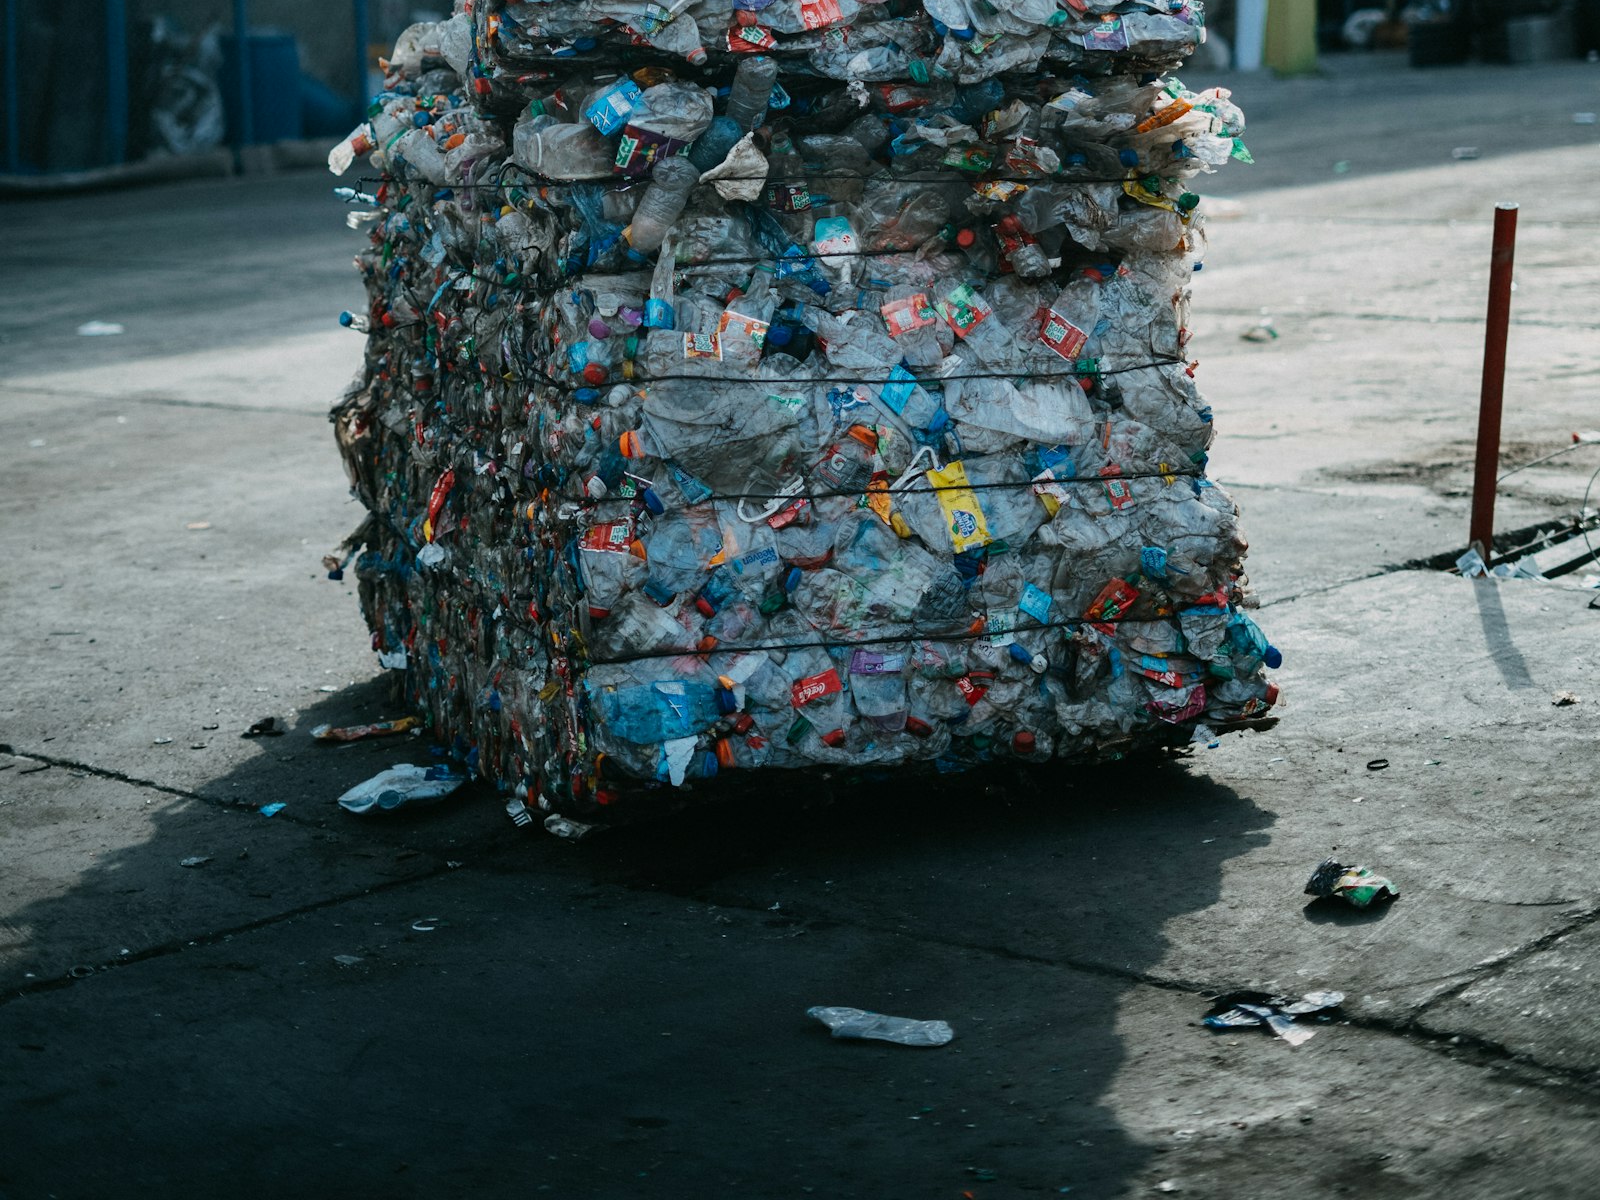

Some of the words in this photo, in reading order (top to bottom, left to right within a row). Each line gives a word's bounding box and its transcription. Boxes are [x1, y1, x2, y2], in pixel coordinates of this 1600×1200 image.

[1046, 327, 1063, 340] Real
[1049, 320, 1065, 335] Kola
[952, 509, 969, 538] COUNTRY
[962, 513, 974, 532] CLUB
[742, 547, 776, 566] Heaven
[760, 554, 778, 566] Cool
[798, 682, 826, 703] Coca-Cola
